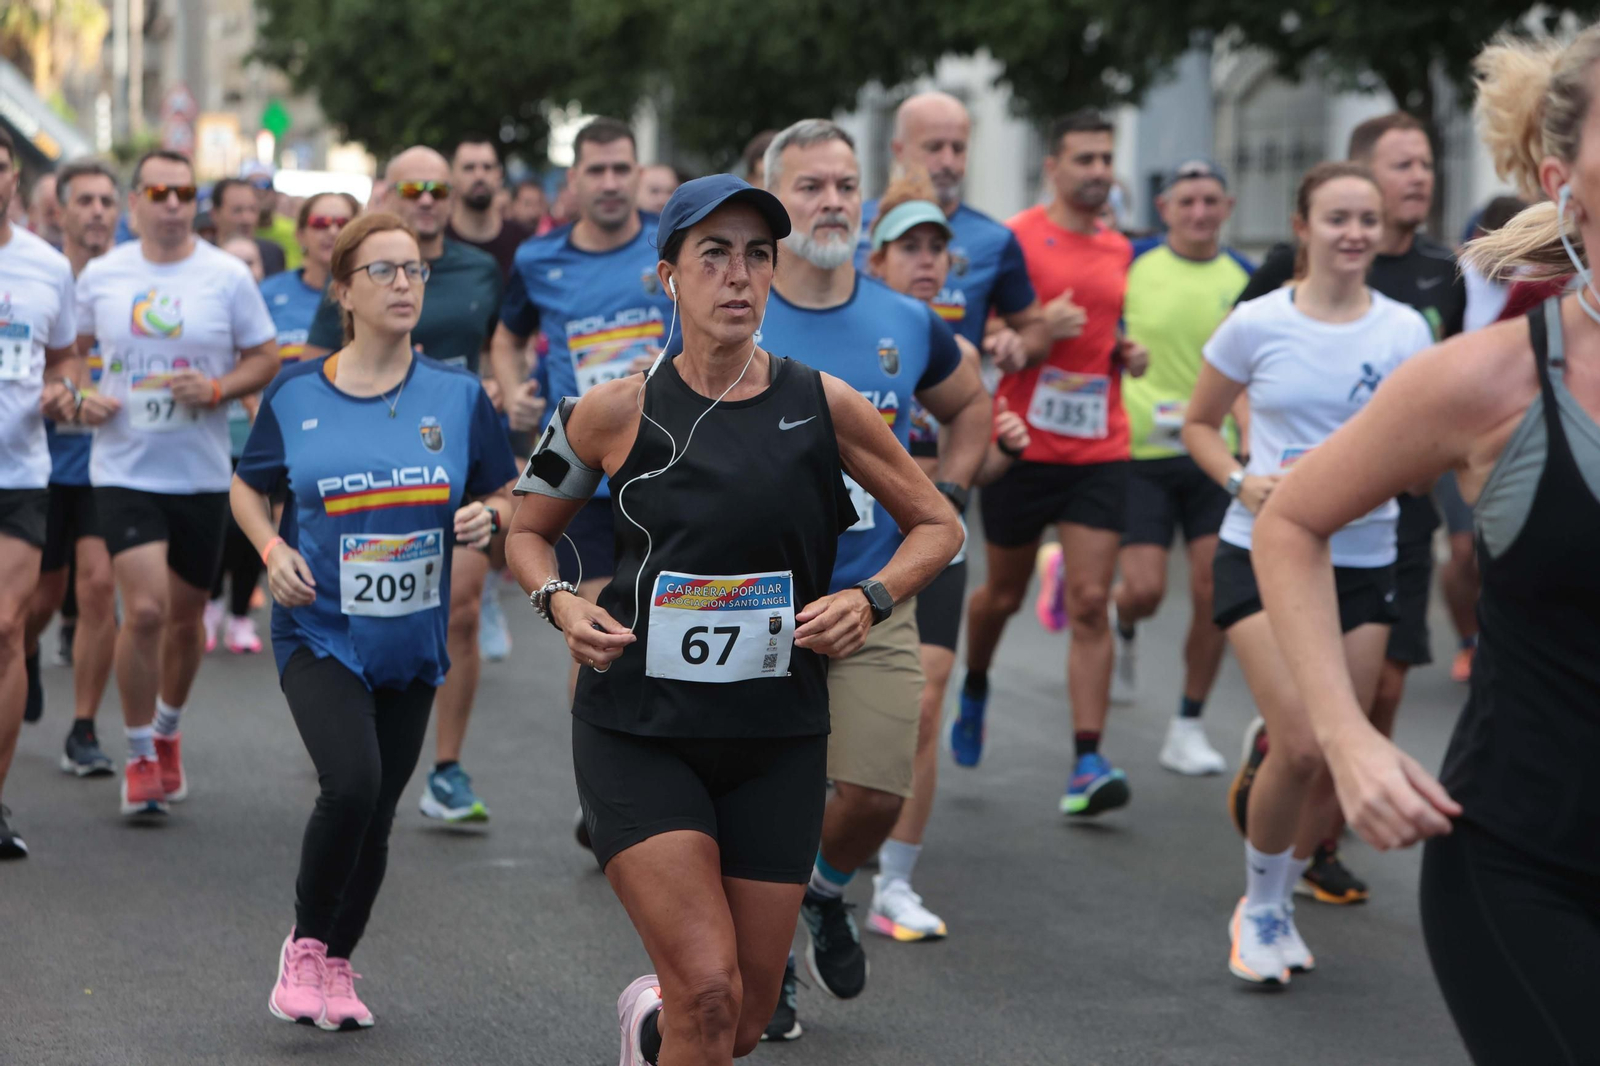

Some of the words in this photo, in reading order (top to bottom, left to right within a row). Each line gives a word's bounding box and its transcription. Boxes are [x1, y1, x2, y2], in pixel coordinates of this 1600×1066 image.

[146, 398, 176, 421] 97
[1045, 398, 1087, 427] 135
[317, 465, 450, 498] POLICIA
[353, 573, 416, 603] 209
[662, 596, 726, 608] ASOCIACION
[728, 599, 759, 608] SANTO
[761, 596, 788, 605] ANGEL
[666, 583, 728, 597] CARRERA
[731, 583, 782, 597] POPULAR
[681, 625, 741, 666] 67
